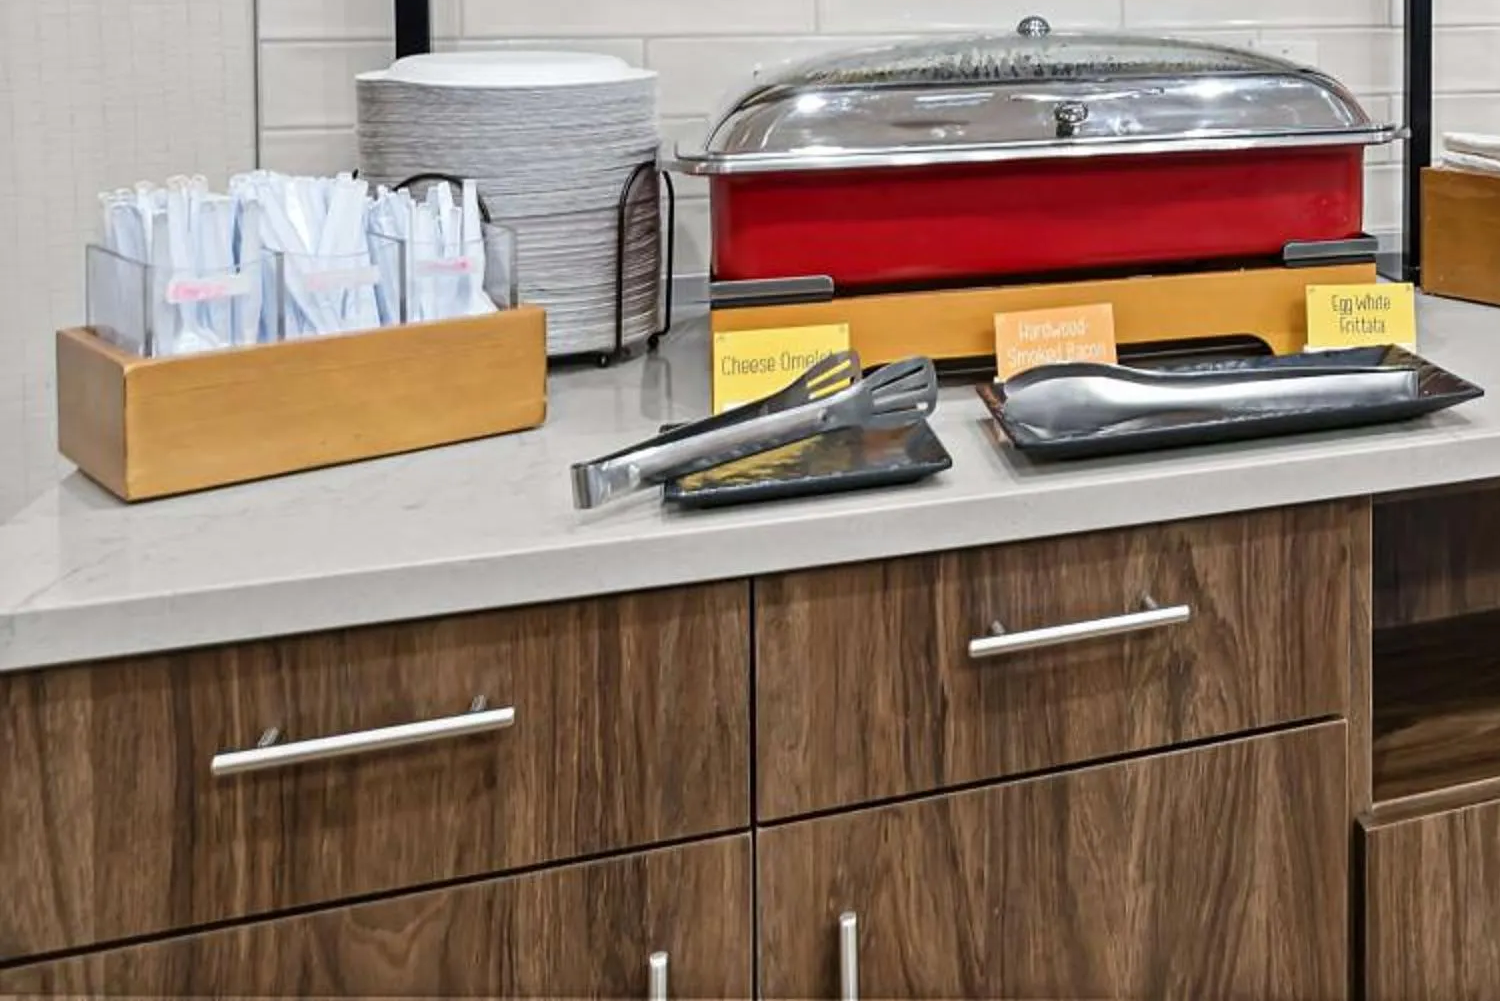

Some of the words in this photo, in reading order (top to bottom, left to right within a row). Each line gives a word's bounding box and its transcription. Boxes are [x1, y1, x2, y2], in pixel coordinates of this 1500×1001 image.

[1331, 294, 1353, 315] Egg
[1356, 293, 1391, 311] White
[721, 354, 777, 375] Cheese
